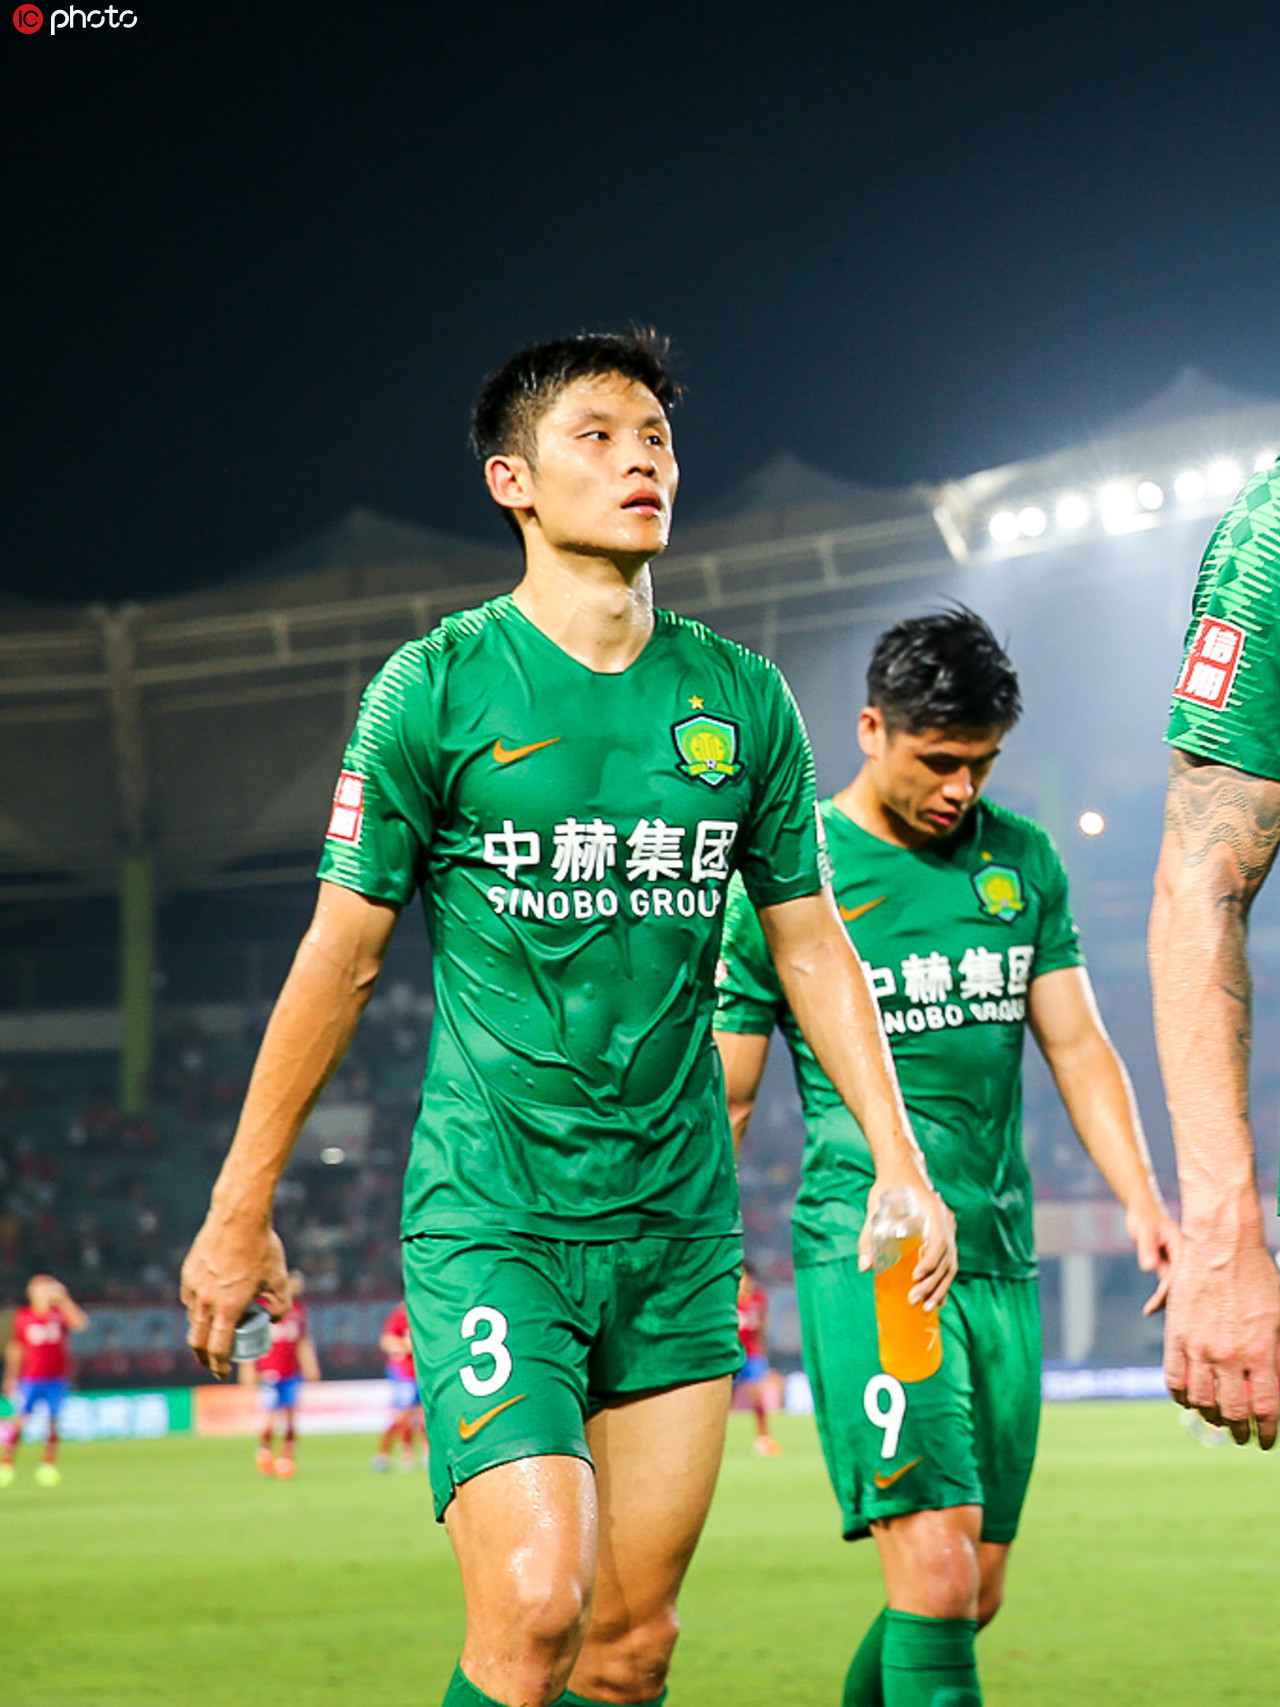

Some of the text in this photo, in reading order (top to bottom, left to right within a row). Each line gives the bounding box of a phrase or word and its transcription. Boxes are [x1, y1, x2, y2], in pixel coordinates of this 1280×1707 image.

[482, 817, 739, 883] 中赫集团
[487, 885, 721, 920] SINOBO GROU
[884, 1004, 964, 1034] NOBO
[460, 1305, 513, 1397] 3
[863, 1373, 907, 1459] 9
